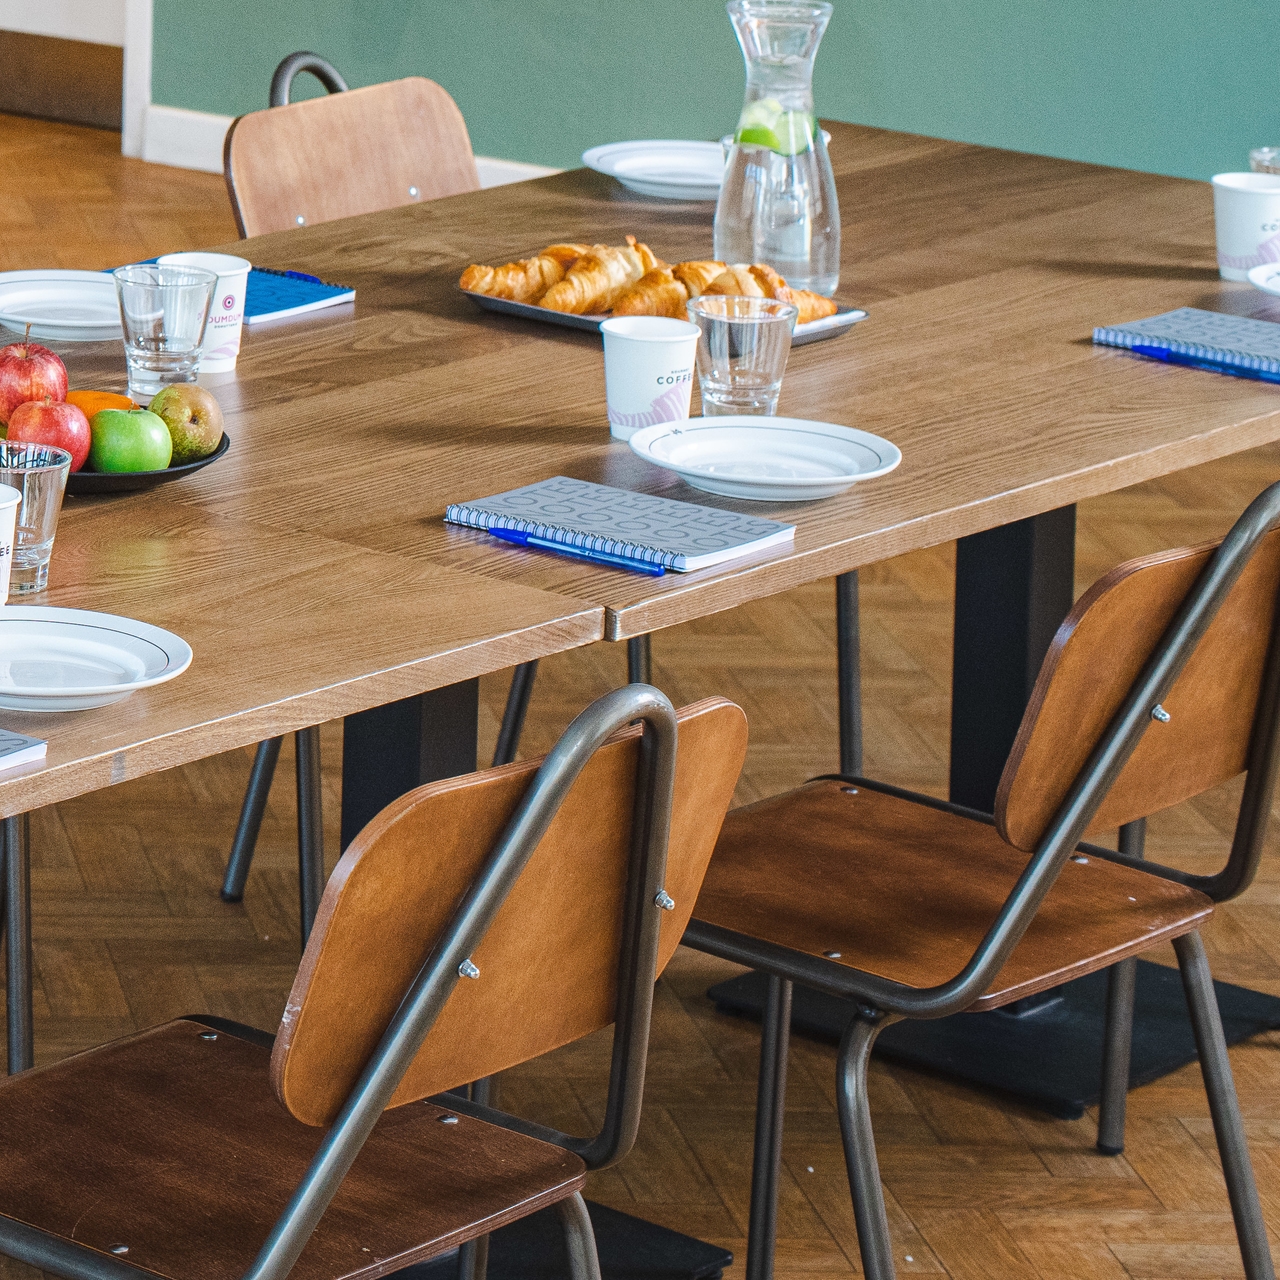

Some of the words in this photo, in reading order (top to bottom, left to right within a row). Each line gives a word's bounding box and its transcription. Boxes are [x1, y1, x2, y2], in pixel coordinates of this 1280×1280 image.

[656, 372, 693, 385] COFFE
[476, 480, 589, 512] NOTES
[511, 488, 628, 521] NOTES
[548, 496, 665, 530] NOTES
[587, 504, 703, 538] NOTES
[625, 511, 742, 545] NOTES
[664, 519, 780, 554] NOTES
